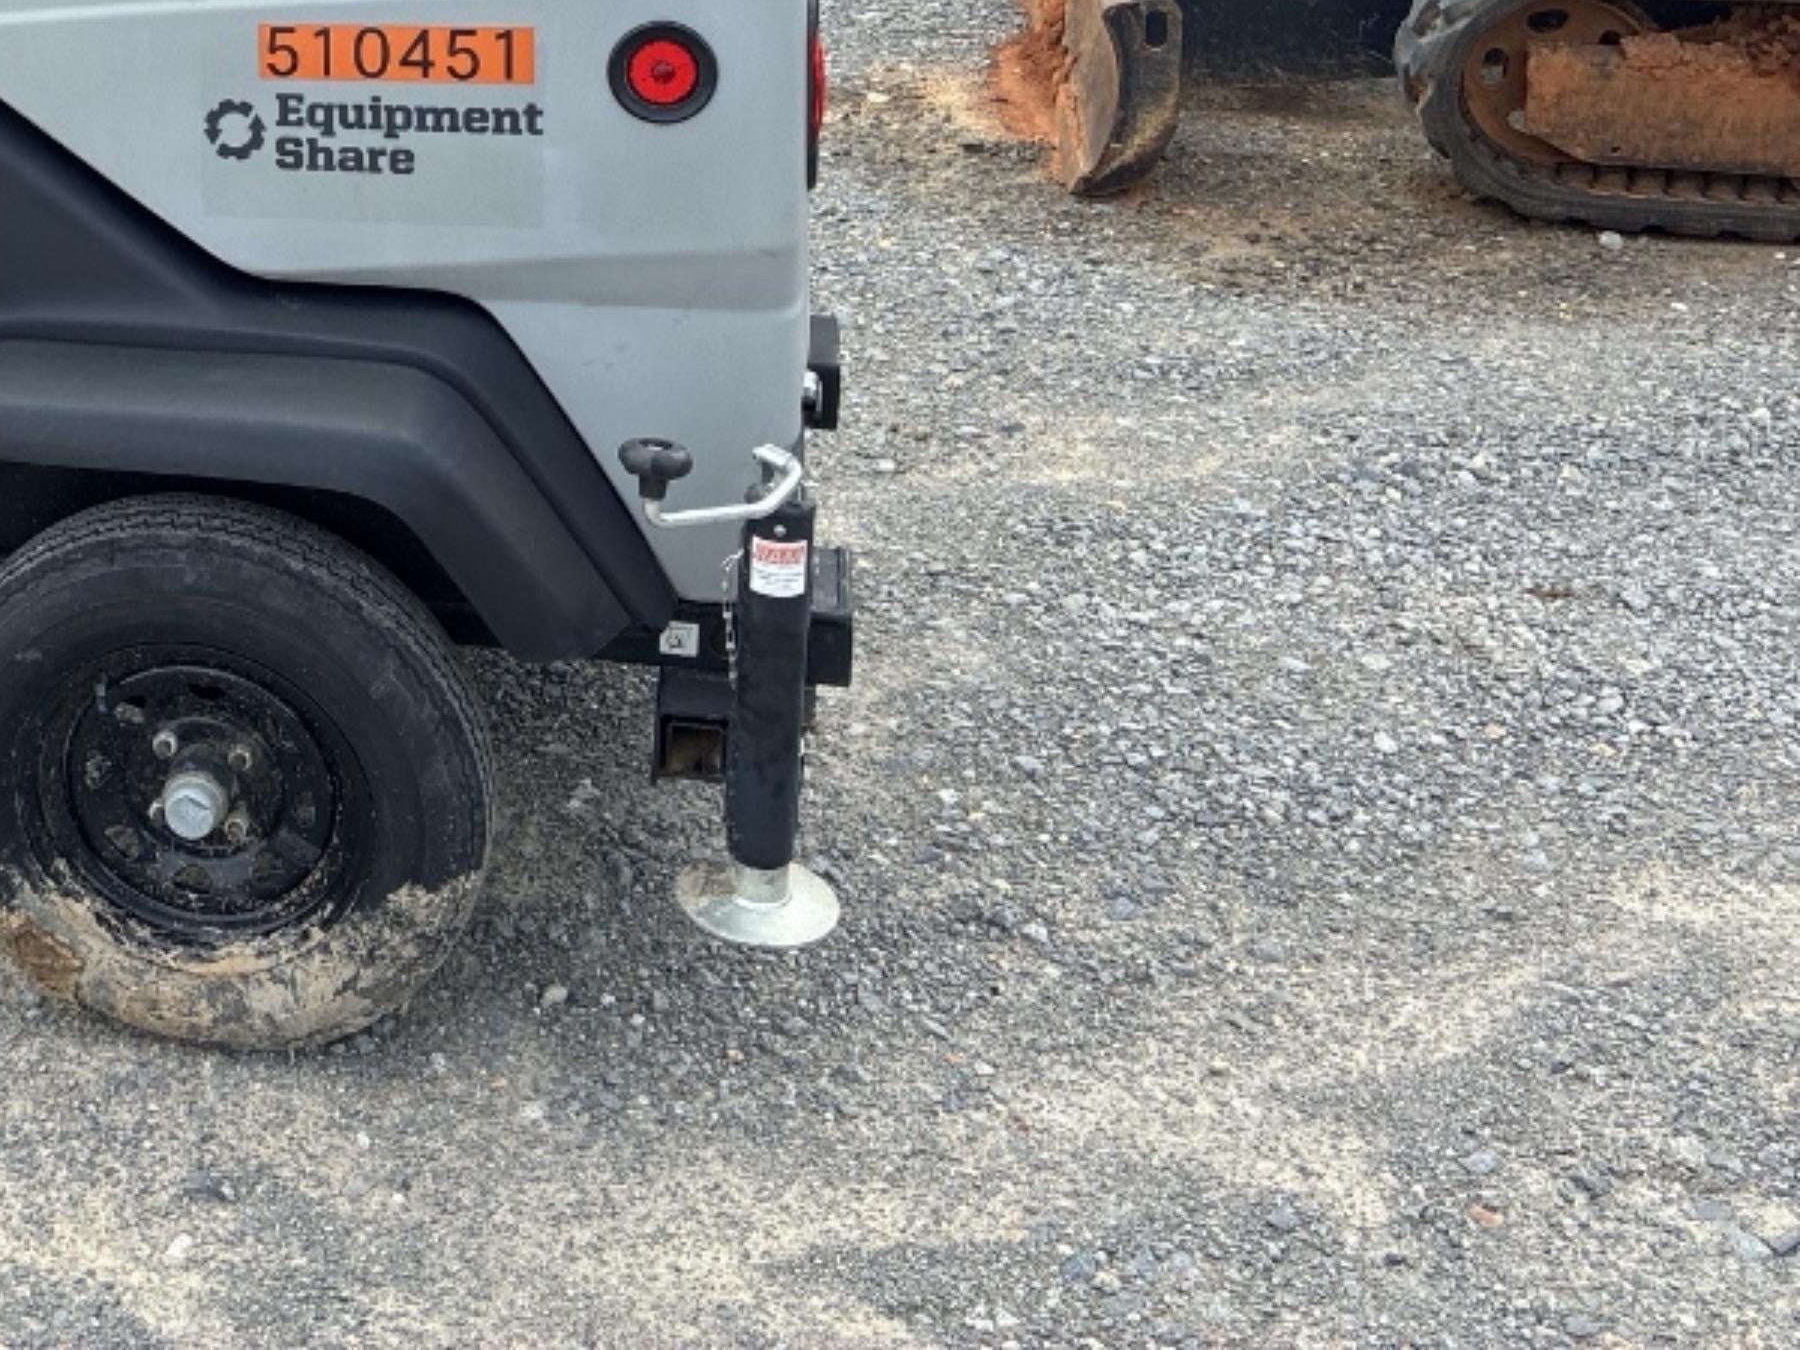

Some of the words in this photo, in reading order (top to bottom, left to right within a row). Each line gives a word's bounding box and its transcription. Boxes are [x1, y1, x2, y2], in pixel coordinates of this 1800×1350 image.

[265, 26, 518, 82] 510451
[274, 92, 545, 140] Equipment
[274, 137, 416, 176] Share
